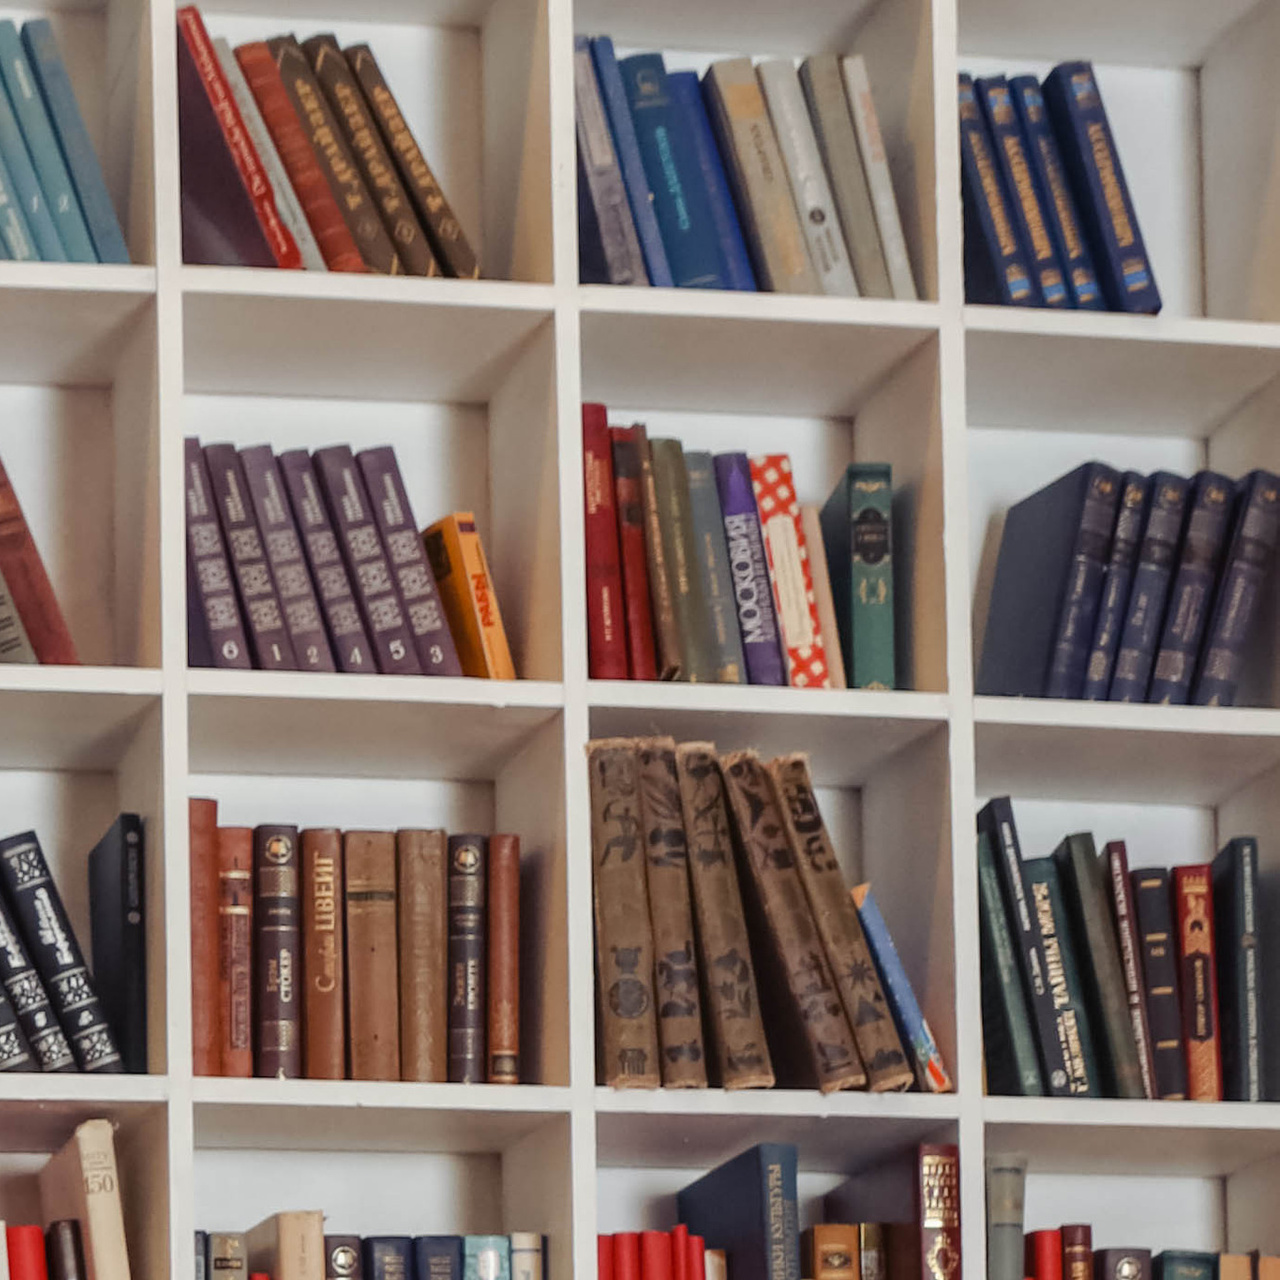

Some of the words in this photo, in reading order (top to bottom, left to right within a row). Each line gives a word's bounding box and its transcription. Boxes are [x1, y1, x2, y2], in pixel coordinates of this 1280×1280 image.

[724, 512, 766, 644] МОСКОВИЯ
[222, 641, 238, 659] 6
[272, 644, 281, 661] 1
[307, 646, 318, 664] 2
[350, 648, 362, 664] 4
[390, 640, 405, 660] 5
[431, 646, 443, 664] 3
[314, 852, 335, 931] ЦВЕЙГ
[278, 948, 292, 1002] СТОКЕР
[84, 1175, 114, 1194] 150
[768, 1164, 785, 1242] КУЛЬТУРЫ
